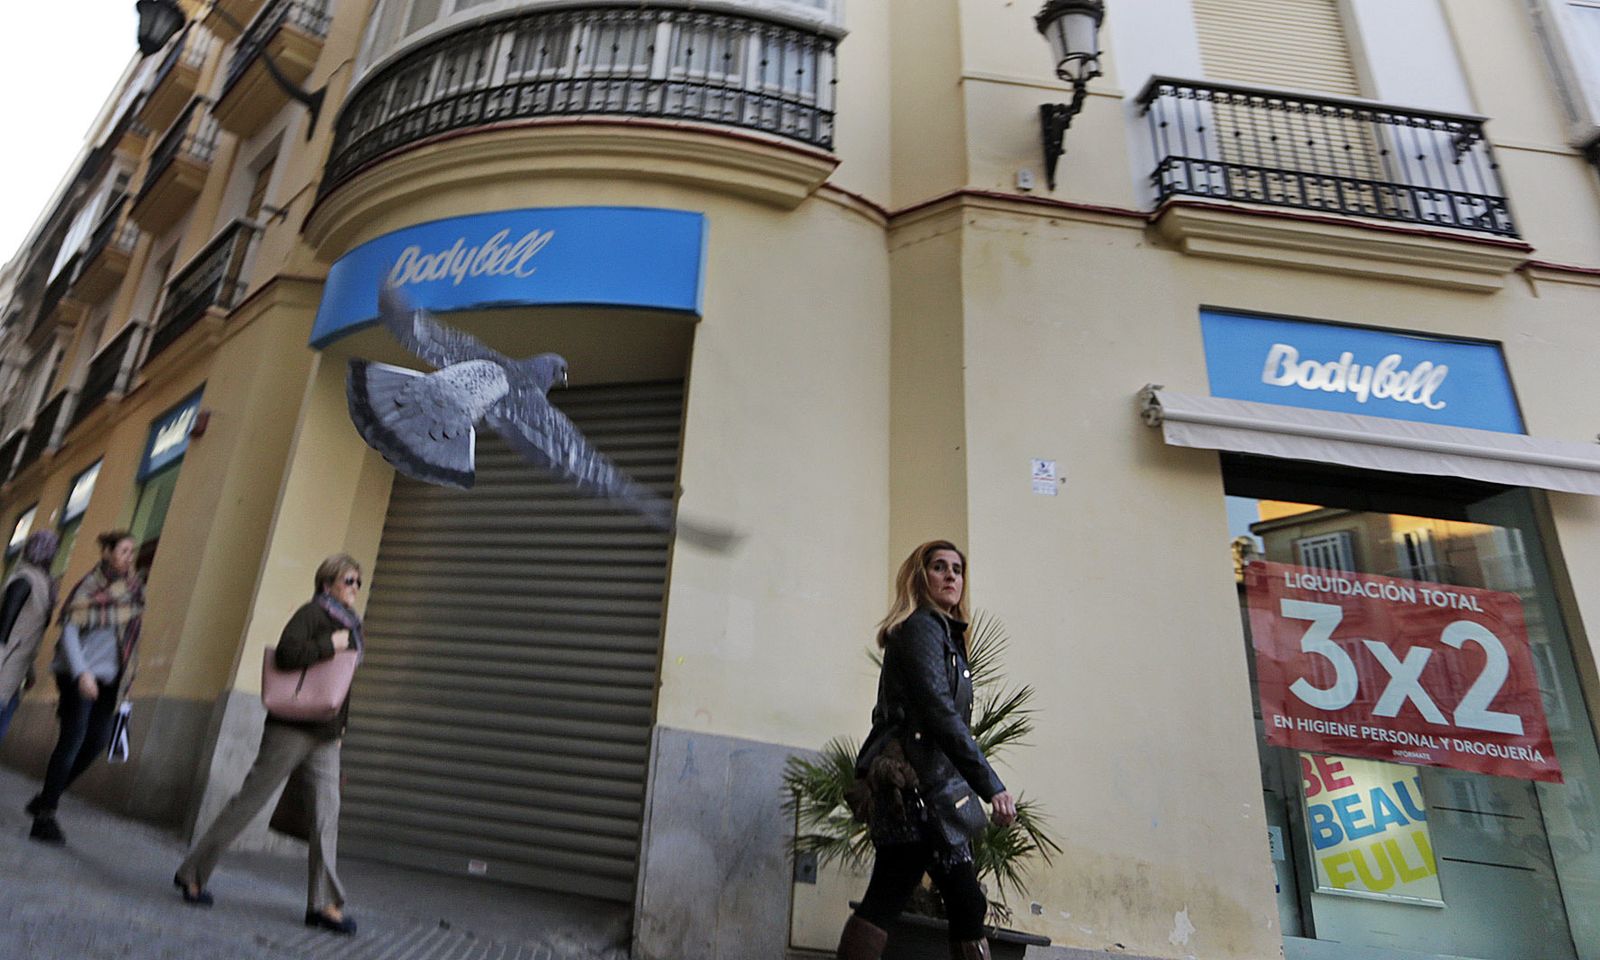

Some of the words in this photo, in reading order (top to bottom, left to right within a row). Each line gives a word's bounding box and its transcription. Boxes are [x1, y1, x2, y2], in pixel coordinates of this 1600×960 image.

[386, 228, 555, 287] Bodybell
[1262, 343, 1448, 409] Bodybell
[1284, 572, 1416, 604] LIQUIDACIÓN
[1421, 588, 1484, 613] TOTAL
[1273, 714, 1294, 729] EN
[1297, 719, 1357, 738] HIGIENE
[1361, 727, 1439, 750] PERSONAL
[1440, 738, 1451, 751] Y
[1453, 740, 1546, 764] DROGUERÍA
[1301, 755, 1354, 798] BE
[1308, 776, 1427, 850] BEAU
